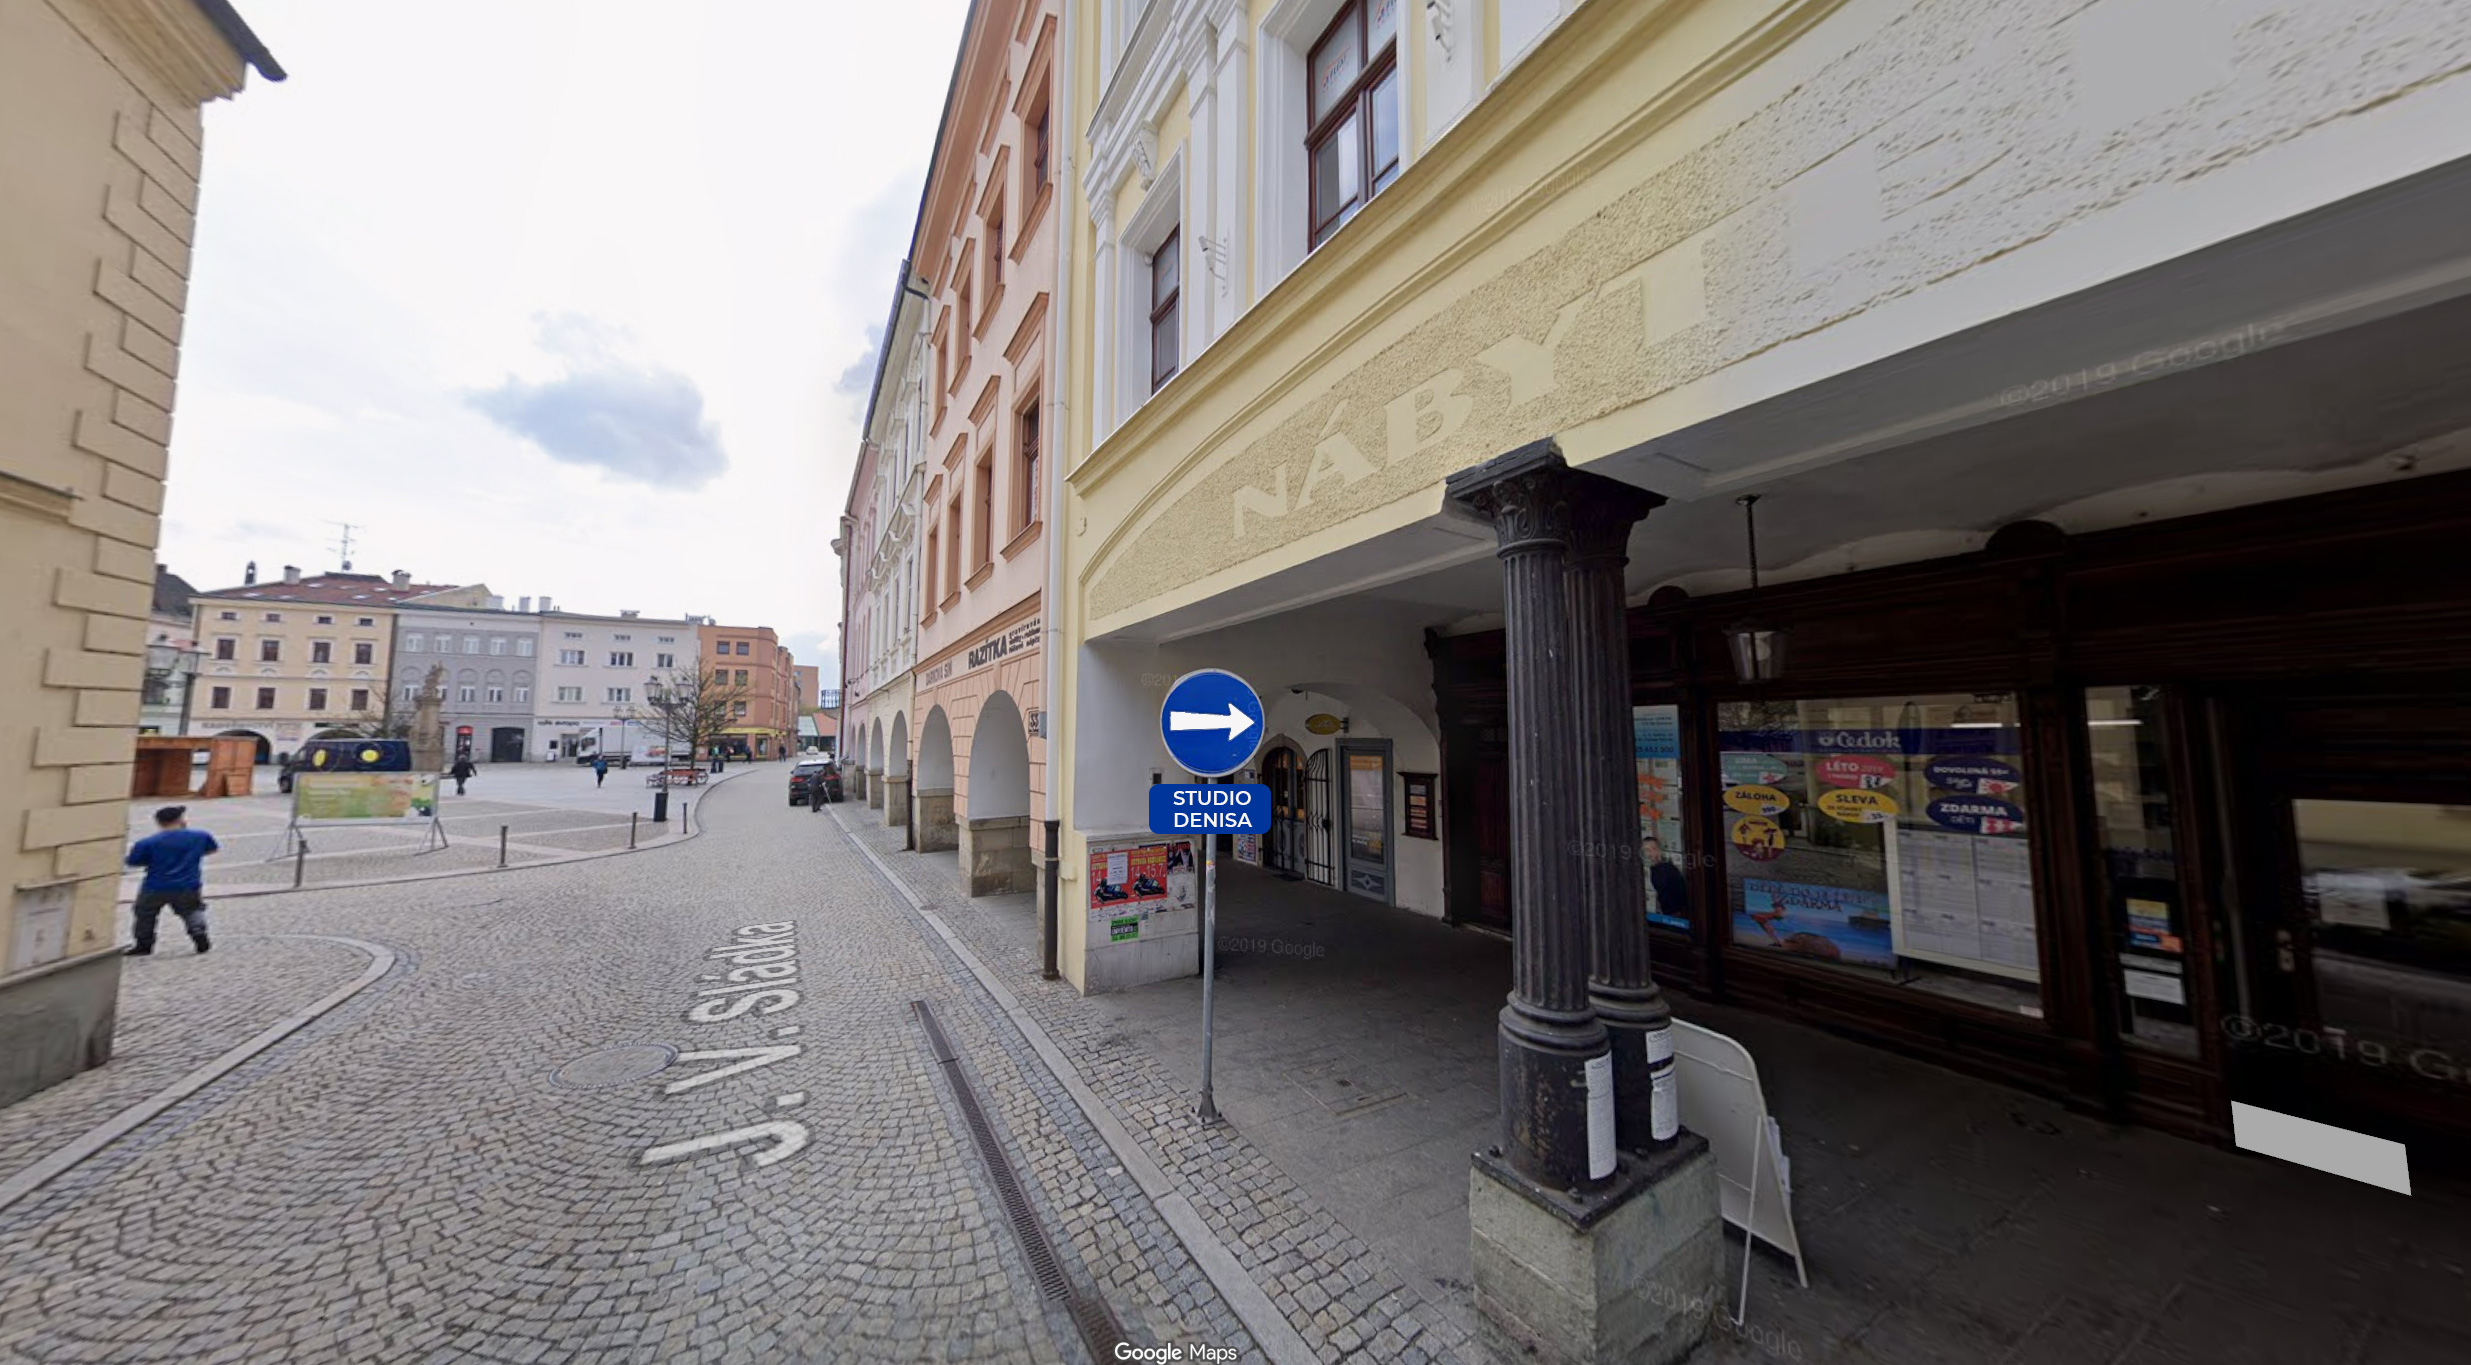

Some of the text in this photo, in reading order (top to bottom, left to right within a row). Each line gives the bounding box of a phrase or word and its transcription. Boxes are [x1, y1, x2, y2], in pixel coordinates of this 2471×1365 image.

[967, 635, 1008, 670] RAZÍTKA
[1825, 760, 1859, 772] LÉTO
[1173, 790, 1252, 806] STUDIO
[1835, 793, 1878, 806] SLEVA
[1940, 802, 2008, 817] ZDARMA
[1173, 812, 1253, 828] DENISA
